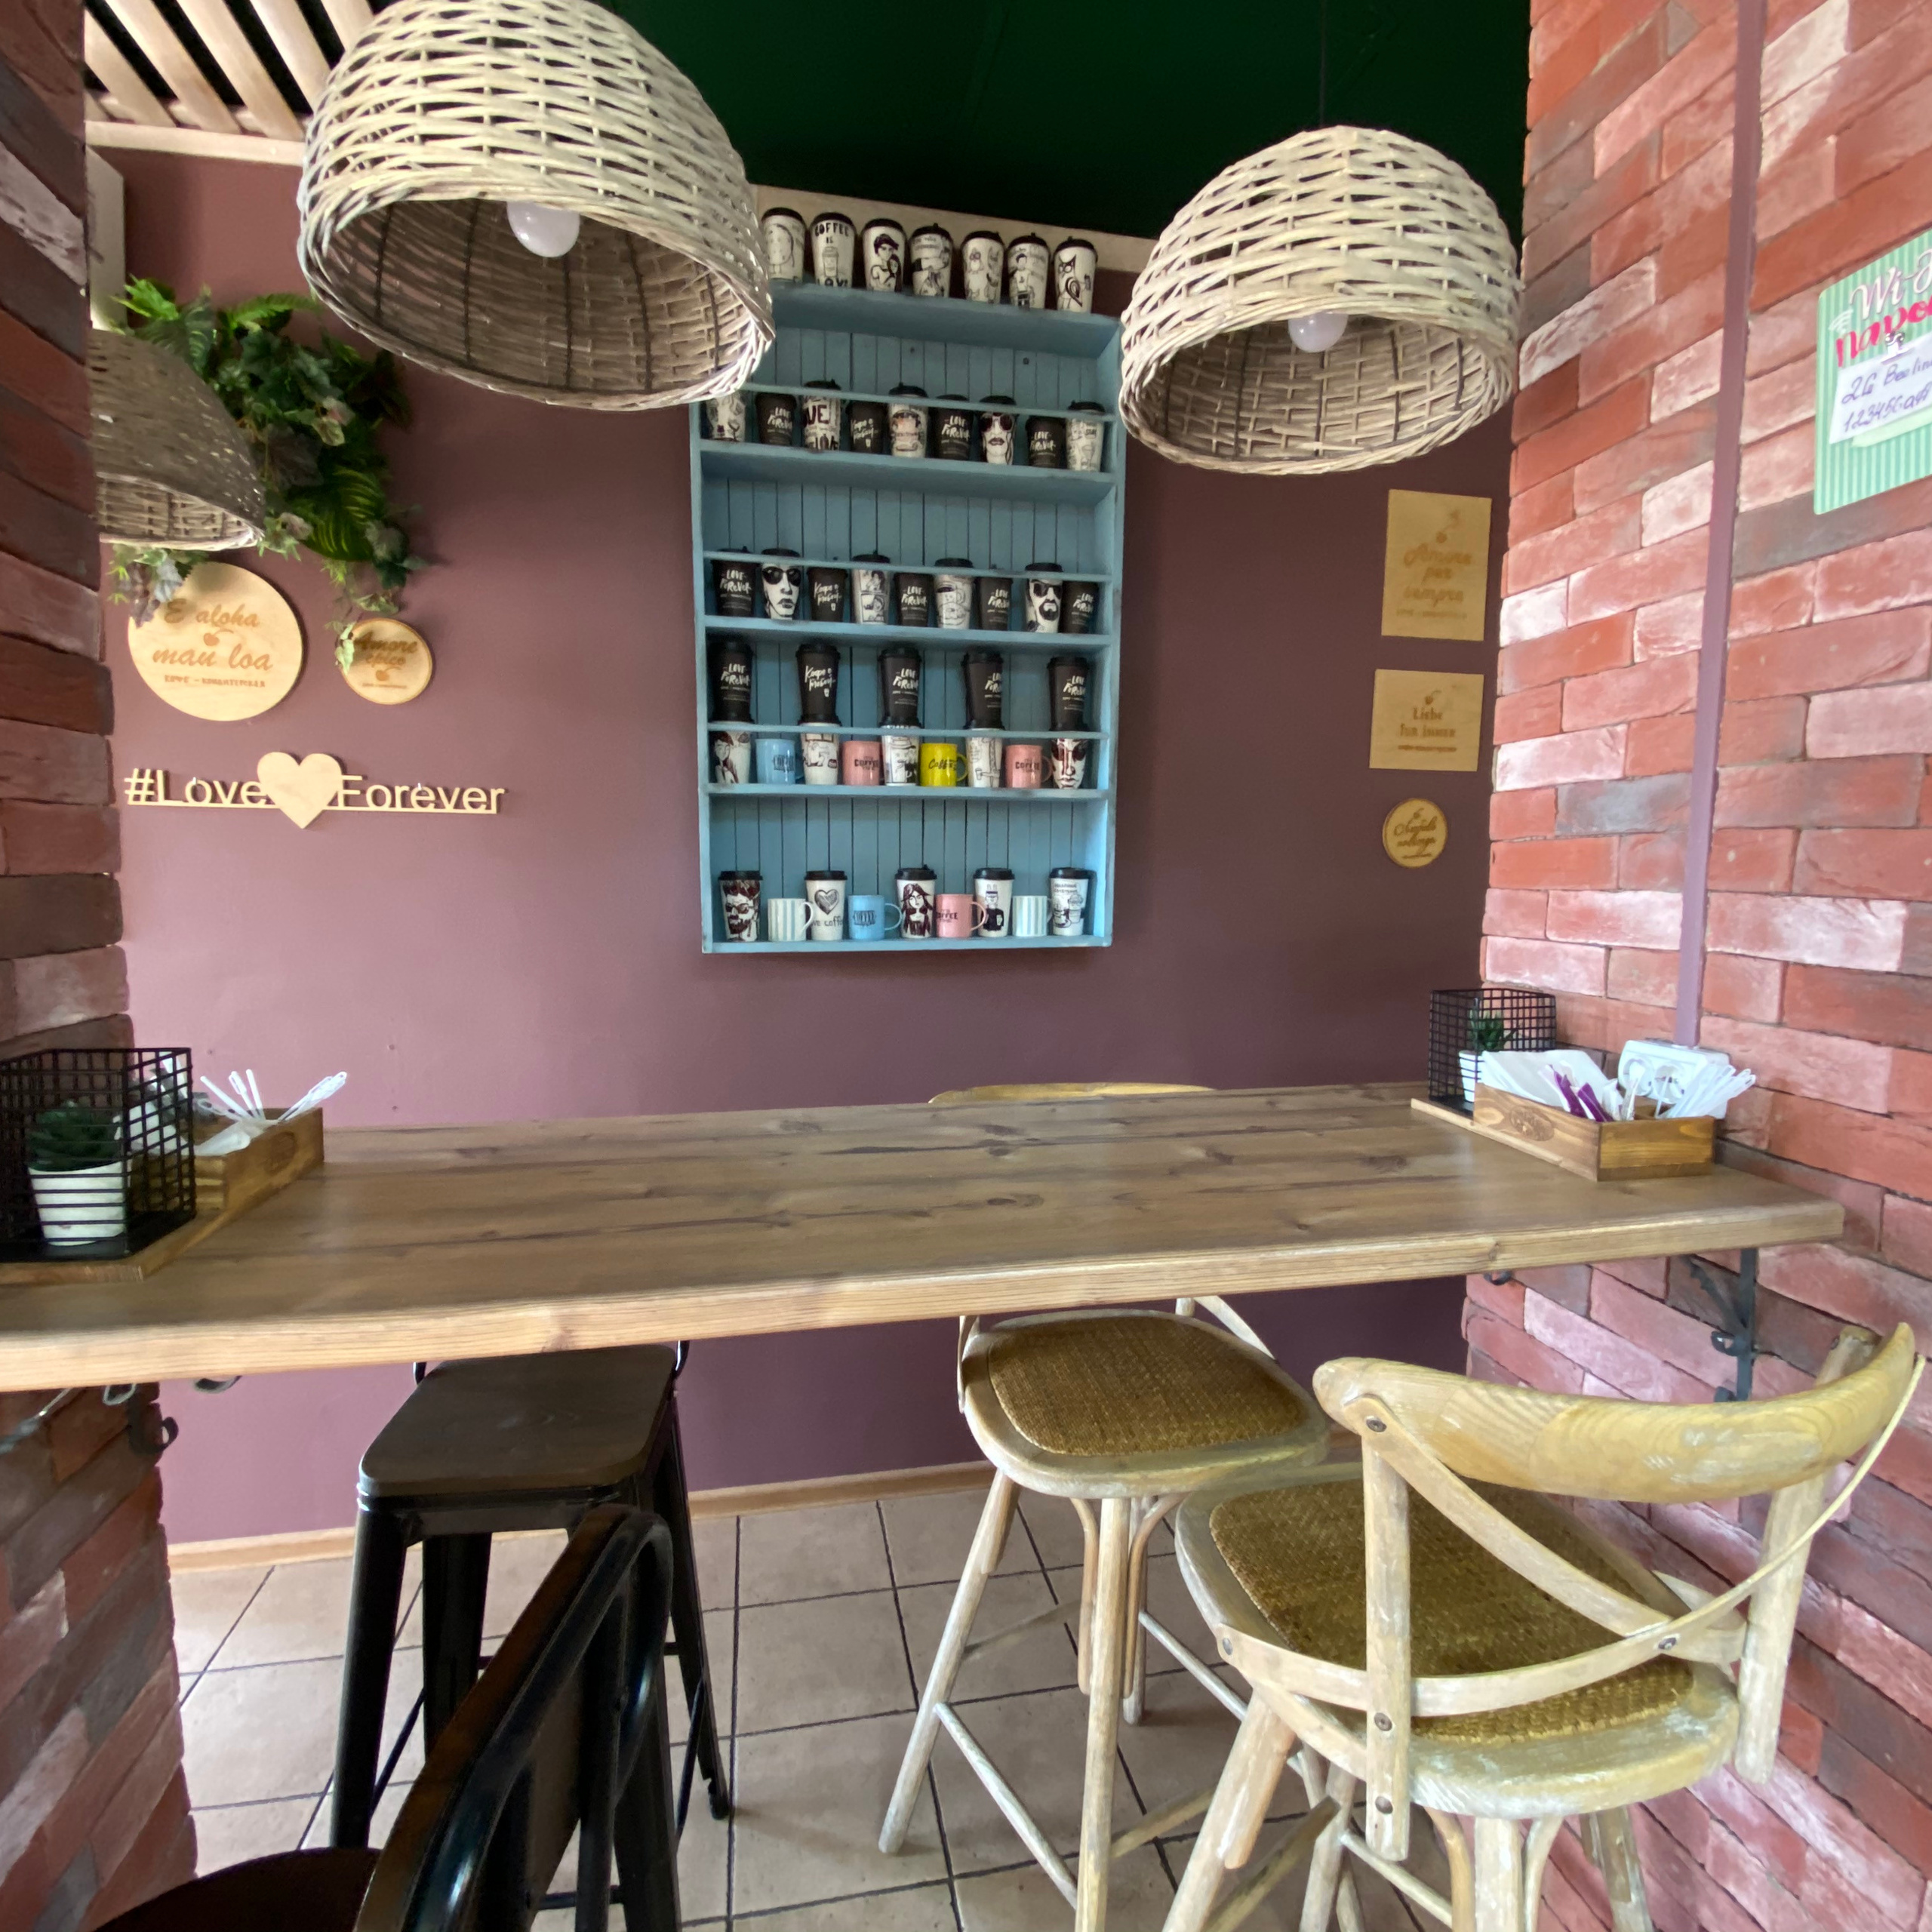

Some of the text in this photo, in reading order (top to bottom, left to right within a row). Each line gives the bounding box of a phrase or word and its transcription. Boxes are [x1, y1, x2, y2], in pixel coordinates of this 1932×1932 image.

[814, 222, 849, 237] COFFEE
[164, 598, 260, 628] E aloha
[152, 643, 273, 671] mau loa
[124, 768, 505, 814] #Love Forever
